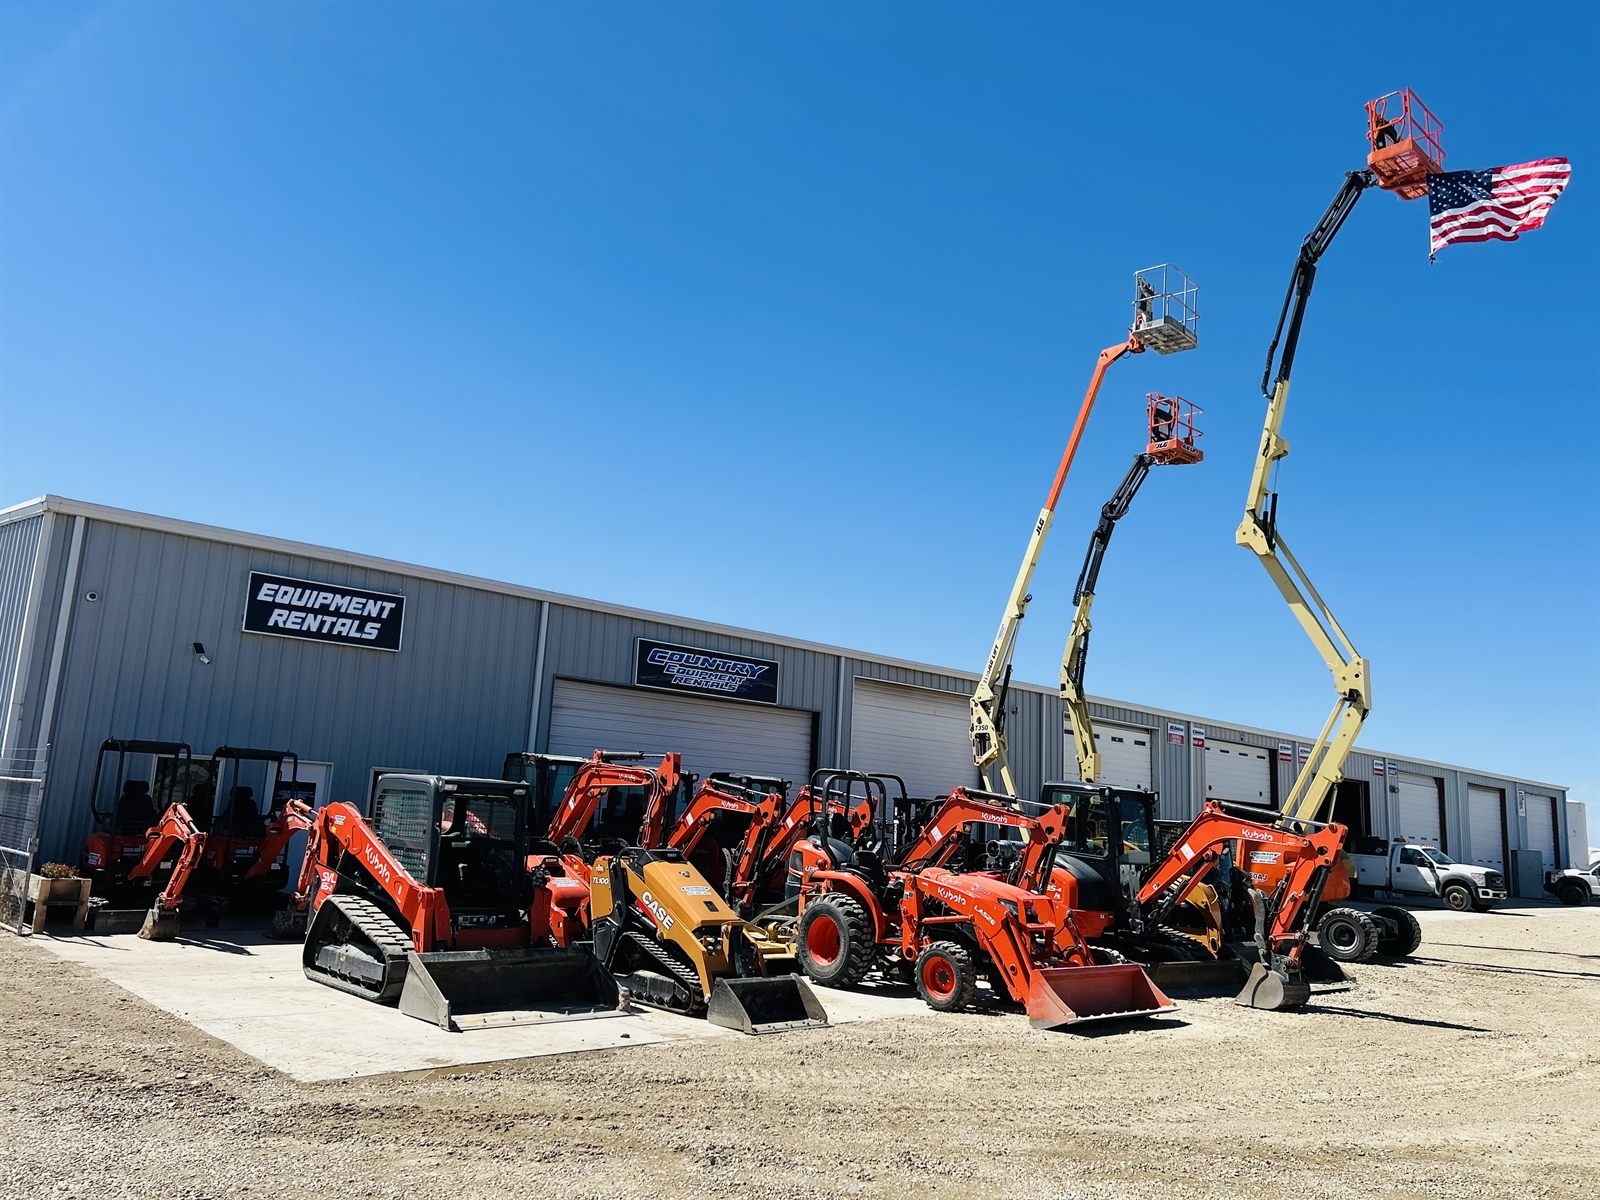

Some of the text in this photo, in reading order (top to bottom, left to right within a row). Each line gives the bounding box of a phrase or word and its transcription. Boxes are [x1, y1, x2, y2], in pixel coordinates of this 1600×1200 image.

[1036, 517, 1045, 536] JLG
[256, 582, 396, 619] EQUIPMENT
[267, 608, 381, 640] RENTALS
[647, 648, 770, 679] COUNTRY
[663, 663, 746, 685] EQUIPMENT
[671, 674, 739, 692] RENTALS
[981, 812, 1008, 823] Kubota
[1241, 828, 1273, 841] Kubota
[365, 843, 391, 884] Kubota
[321, 871, 336, 884] SVL
[592, 876, 609, 885] TL100
[937, 887, 967, 906] Kubota
[641, 890, 675, 930] CASE
